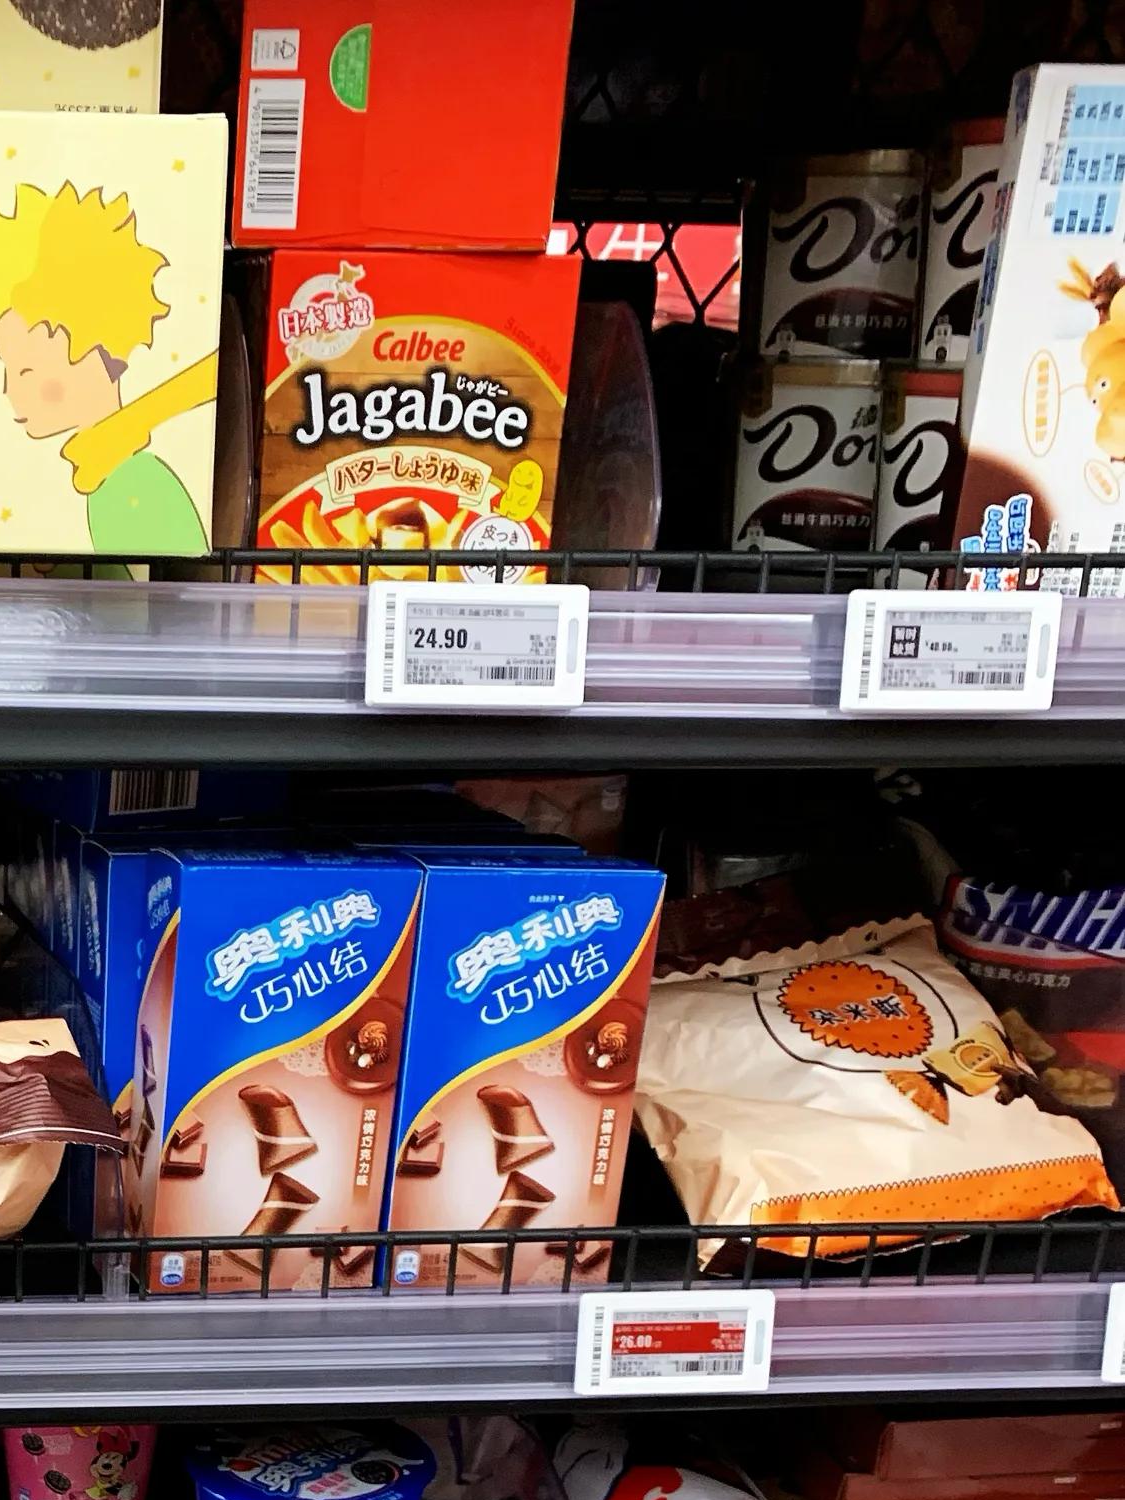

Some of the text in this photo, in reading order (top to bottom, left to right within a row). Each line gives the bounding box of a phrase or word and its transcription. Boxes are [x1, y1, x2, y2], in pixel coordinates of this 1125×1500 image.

[372, 331, 466, 363] Calbee
[295, 371, 529, 448] Jagabee
[334, 452, 485, 492] バターしょうゆ味
[212, 891, 379, 991] 奥利奥
[454, 897, 621, 992] 奥利奥
[240, 941, 368, 1024] 巧心结
[480, 944, 609, 1026] 巧心结
